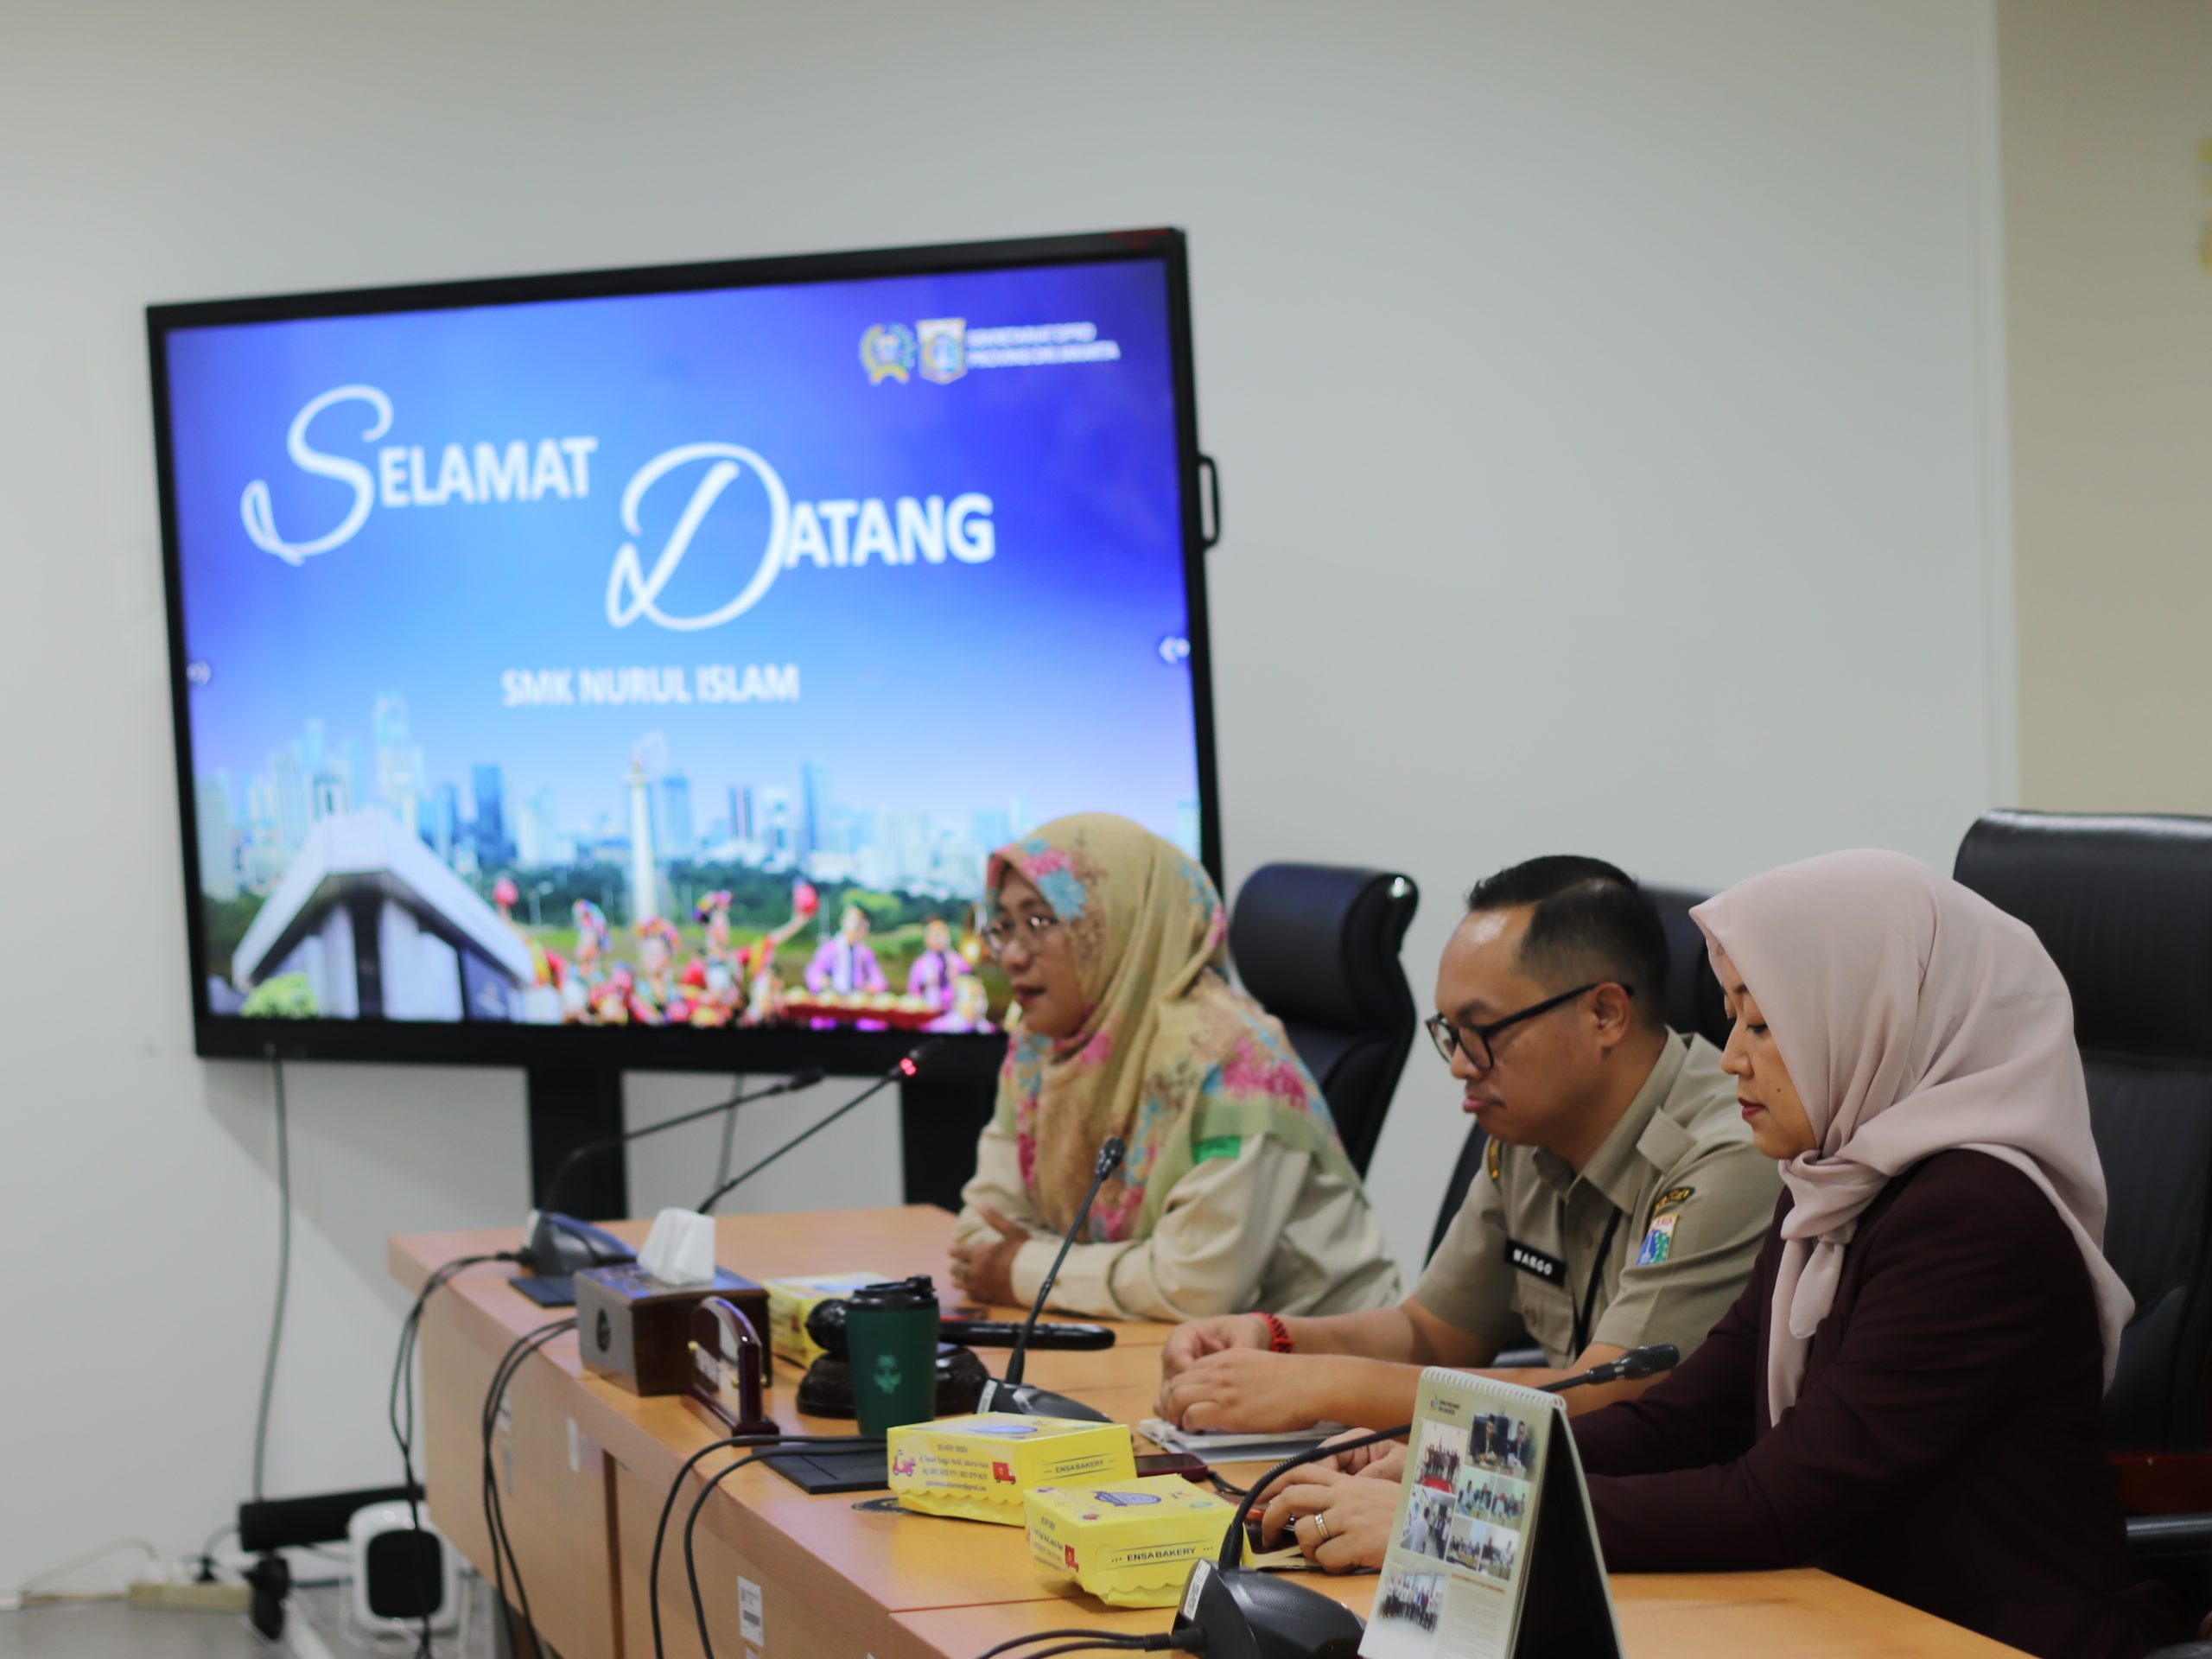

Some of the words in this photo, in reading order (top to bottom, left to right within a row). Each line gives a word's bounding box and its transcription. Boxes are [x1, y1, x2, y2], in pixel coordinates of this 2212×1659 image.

[240, 384, 598, 567] SELAMAT
[606, 442, 996, 632] DATANG
[501, 669, 574, 708] SMK
[578, 665, 692, 706] NURUL
[696, 663, 800, 703] ISLAM
